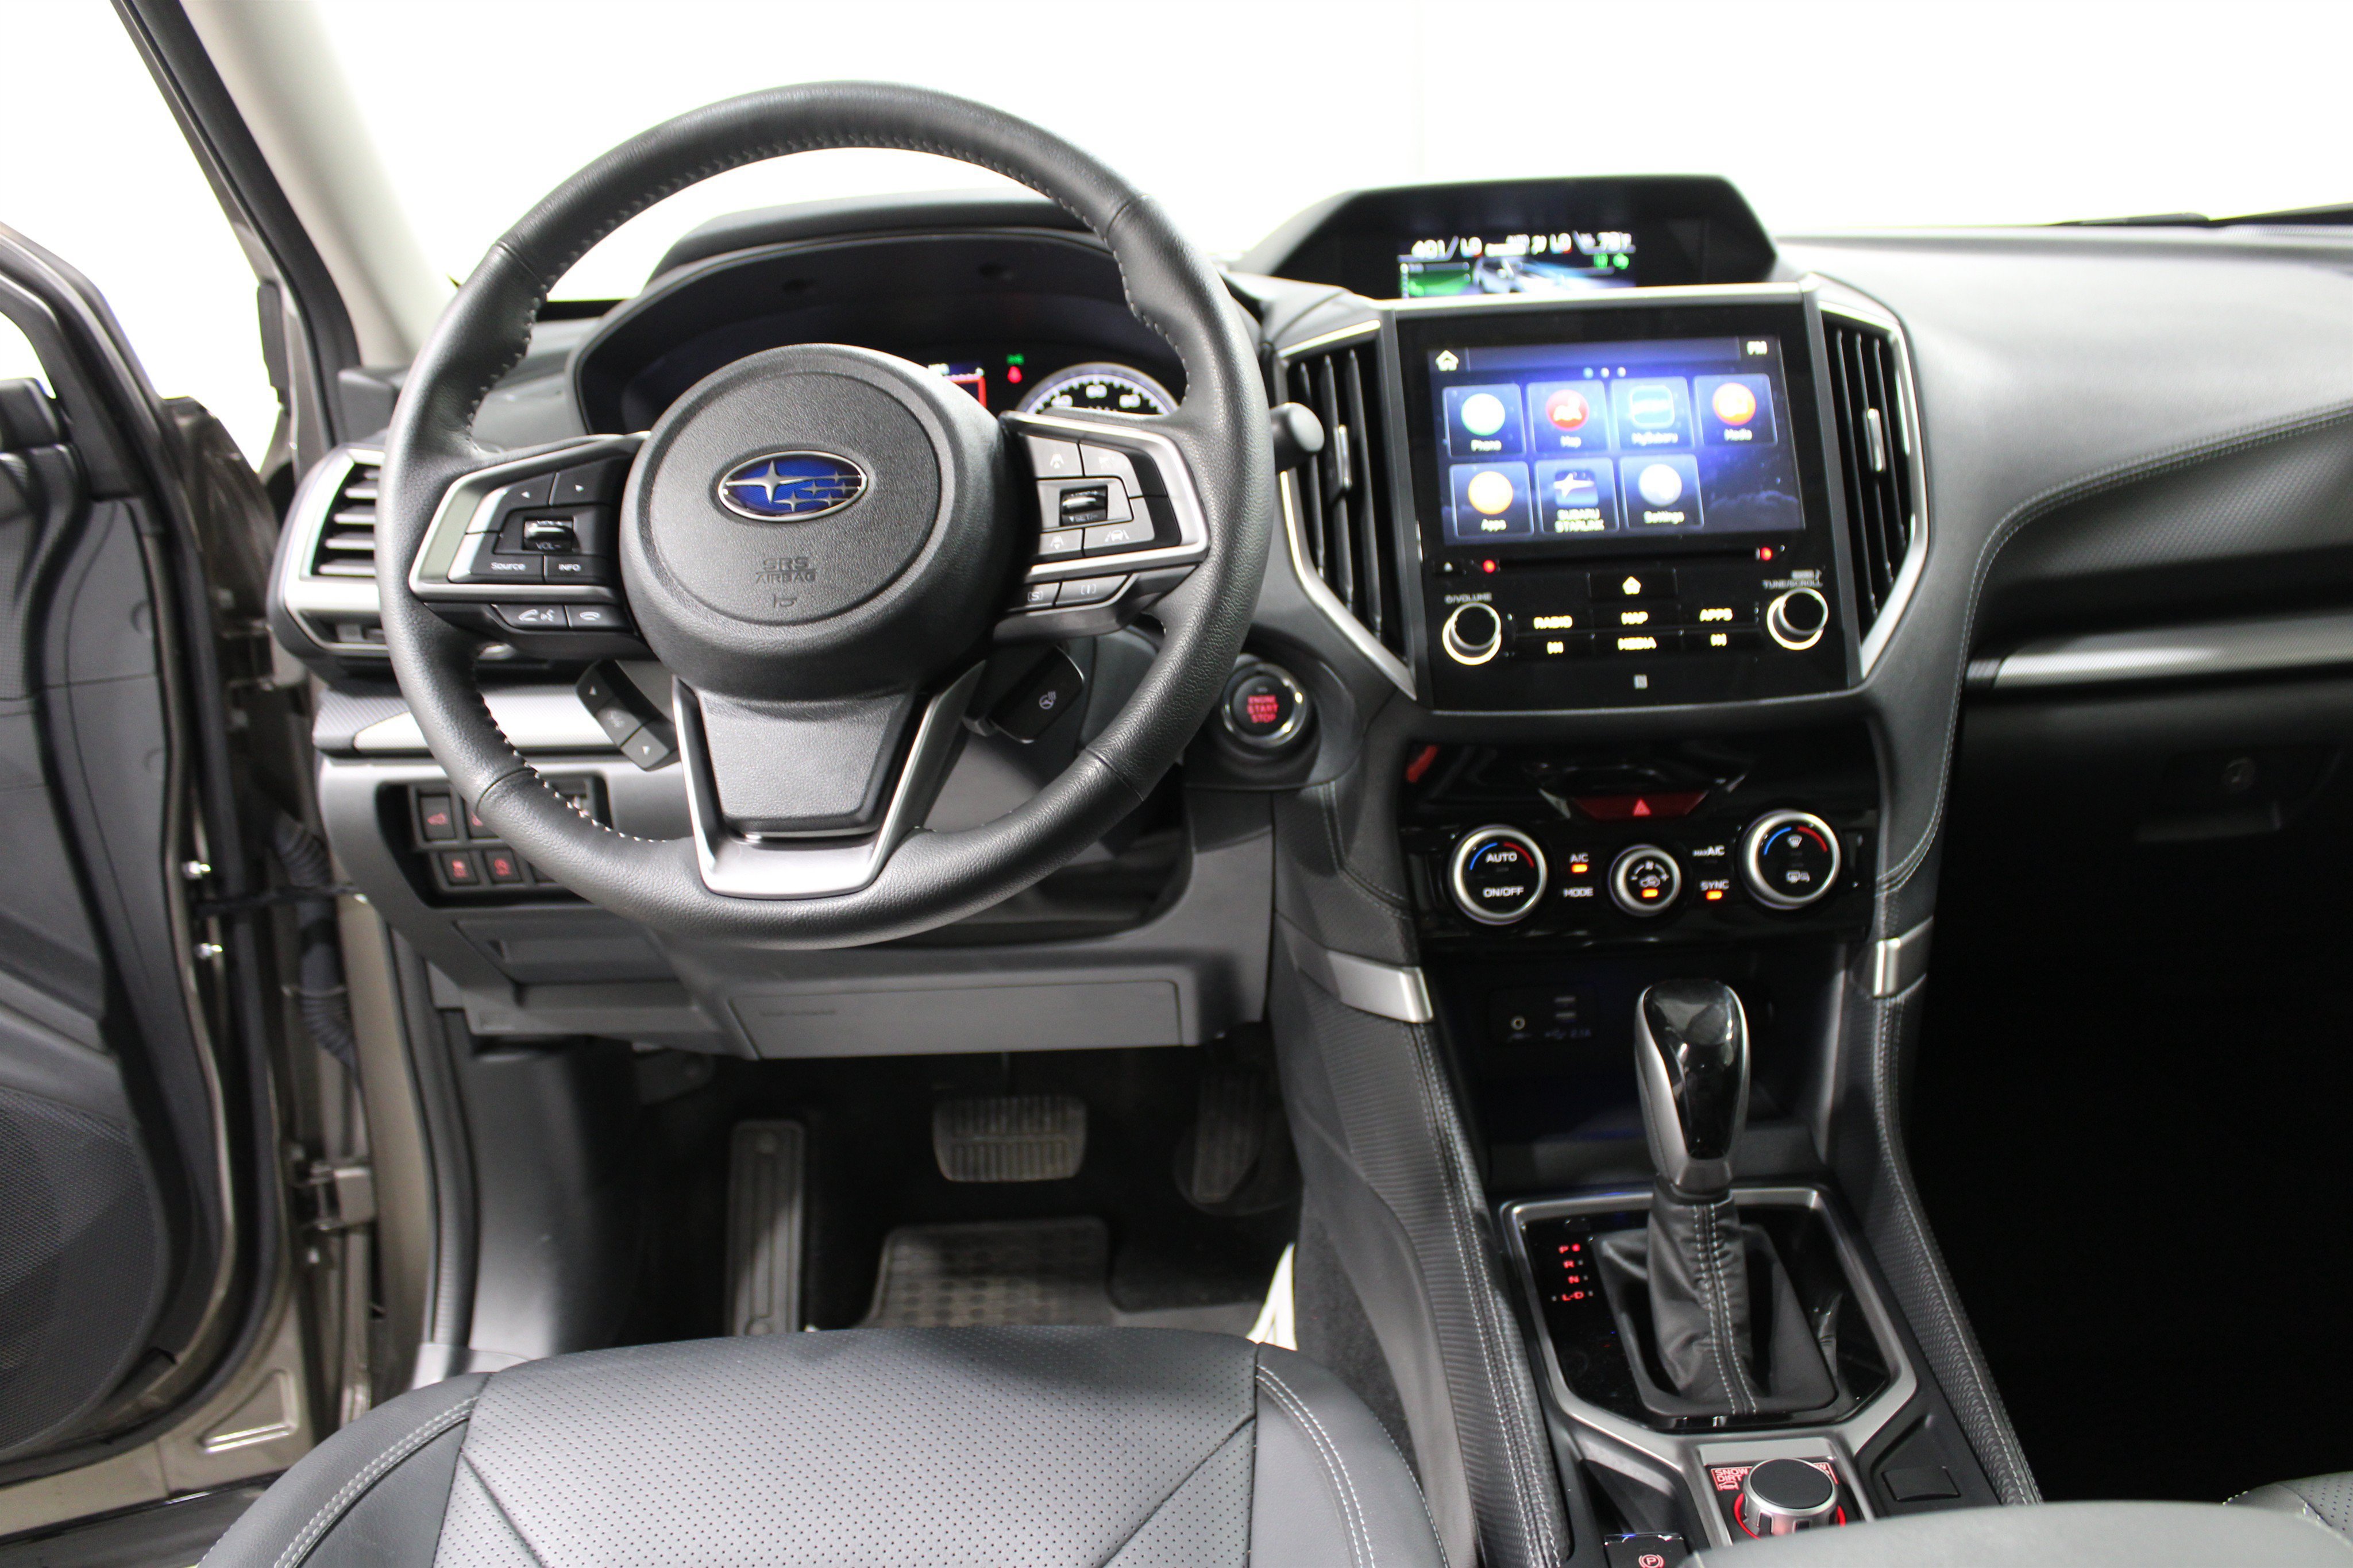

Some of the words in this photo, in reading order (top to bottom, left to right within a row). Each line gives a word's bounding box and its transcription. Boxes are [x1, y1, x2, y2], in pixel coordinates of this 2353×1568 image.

[558, 563, 581, 571] INFO
[763, 556, 809, 570] SRS
[755, 569, 816, 584] AIRBAG
[1621, 611, 1649, 625] MAP
[1699, 608, 1733, 621] APPS
[1533, 615, 1573, 629] RADIO
[1617, 636, 1657, 650] MEDIA
[1247, 703, 1279, 715] START
[1251, 713, 1276, 723] STOP
[1485, 851, 1518, 863] AUTO
[1569, 852, 1590, 863] A/C
[1700, 879, 1730, 891] SYNC
[1483, 886, 1525, 898] ON/OFF
[1563, 886, 1594, 898] MODE
[1559, 1244, 1569, 1254] P
[1563, 1259, 1575, 1269] R
[1568, 1275, 1580, 1284] N
[1714, 1468, 1749, 1476] SNOW
[1716, 1474, 1743, 1482] DIRT
